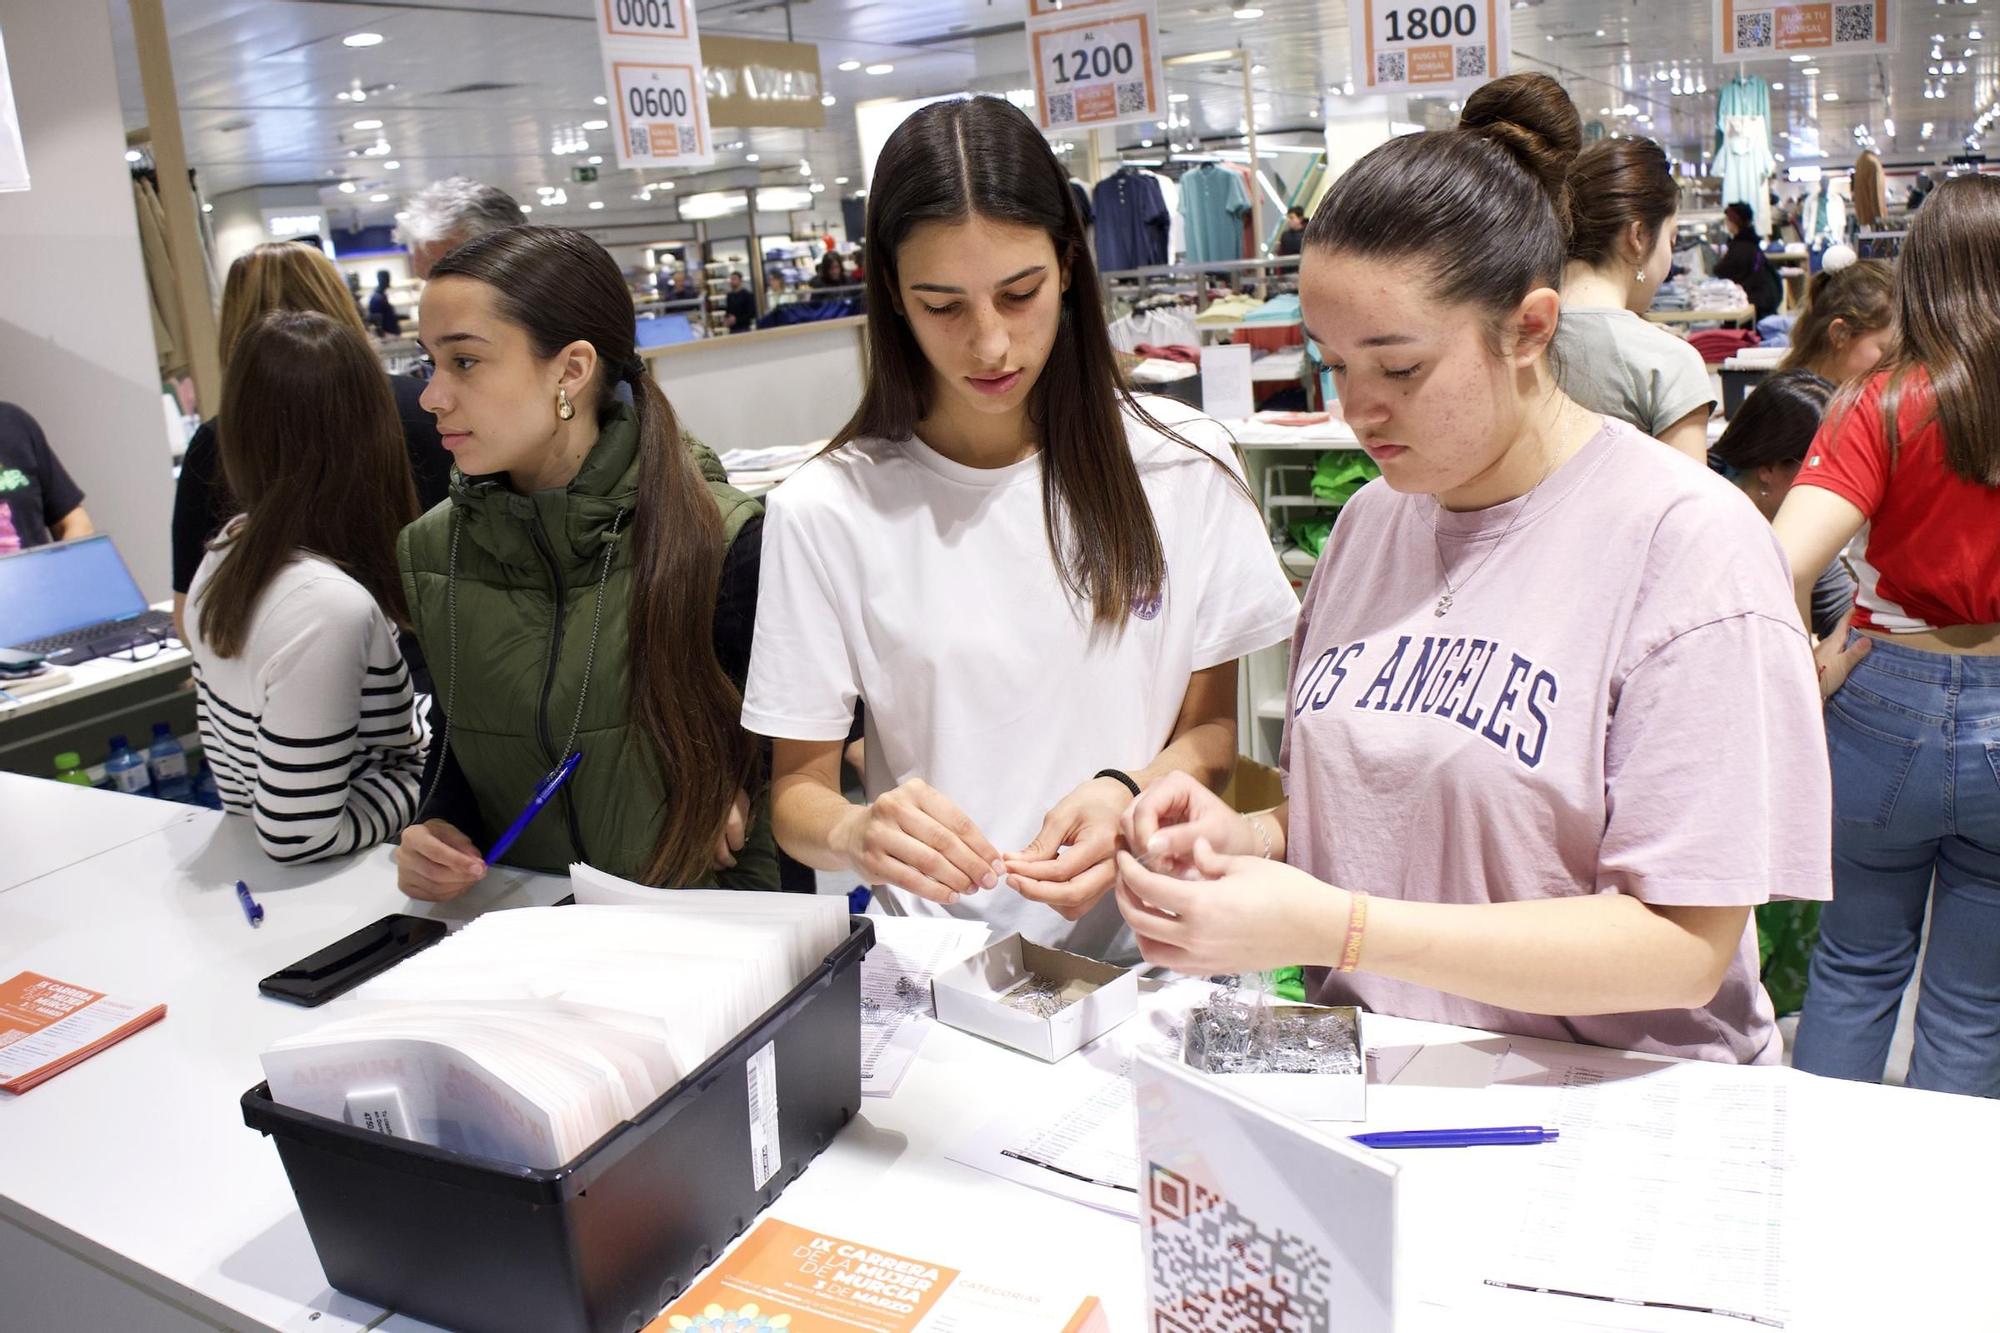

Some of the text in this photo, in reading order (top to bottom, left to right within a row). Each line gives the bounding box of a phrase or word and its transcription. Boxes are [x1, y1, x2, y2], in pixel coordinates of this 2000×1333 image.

[616, 0, 676, 29] 0001
[1385, 4, 1477, 42] 1800
[1814, 11, 1827, 20] TU
[1084, 33, 1096, 41] AL
[1052, 42, 1133, 84] 1200
[629, 87, 687, 117] 0600
[1294, 636, 1558, 769] OS ANGELES
[792, 1245, 933, 1292] DE LA MUJER
[809, 1237, 939, 1281] IX CARRERA
[800, 1261, 833, 1278] DE
[832, 1270, 921, 1304] MURCIA
[813, 1279, 827, 1290] 3
[826, 1283, 851, 1297] DE
[850, 1291, 914, 1314] MARZO
